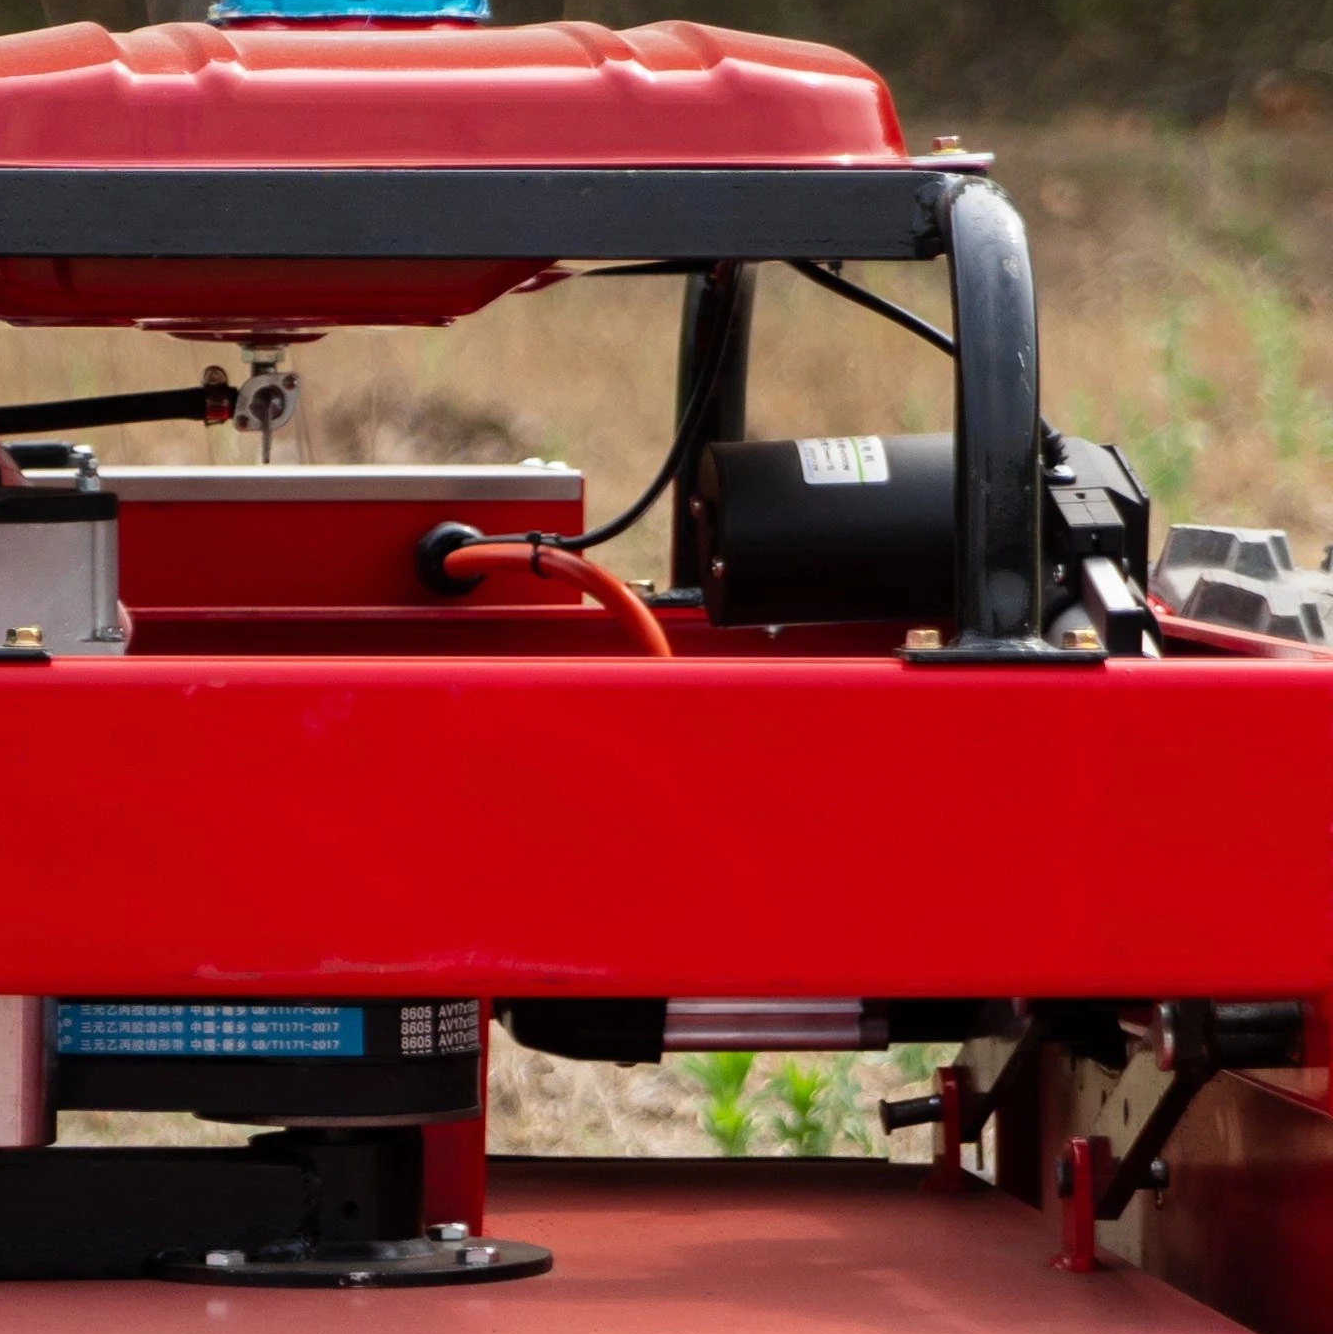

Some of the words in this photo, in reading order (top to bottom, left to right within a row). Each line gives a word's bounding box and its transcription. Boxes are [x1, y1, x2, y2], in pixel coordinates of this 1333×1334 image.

[400, 1006, 433, 1021] 8605
[251, 1021, 341, 1034] GB/T1171-2017
[400, 1021, 433, 1035] 8605
[251, 1038, 341, 1051] GB/T1171-2017
[400, 1035, 433, 1050] 8605
